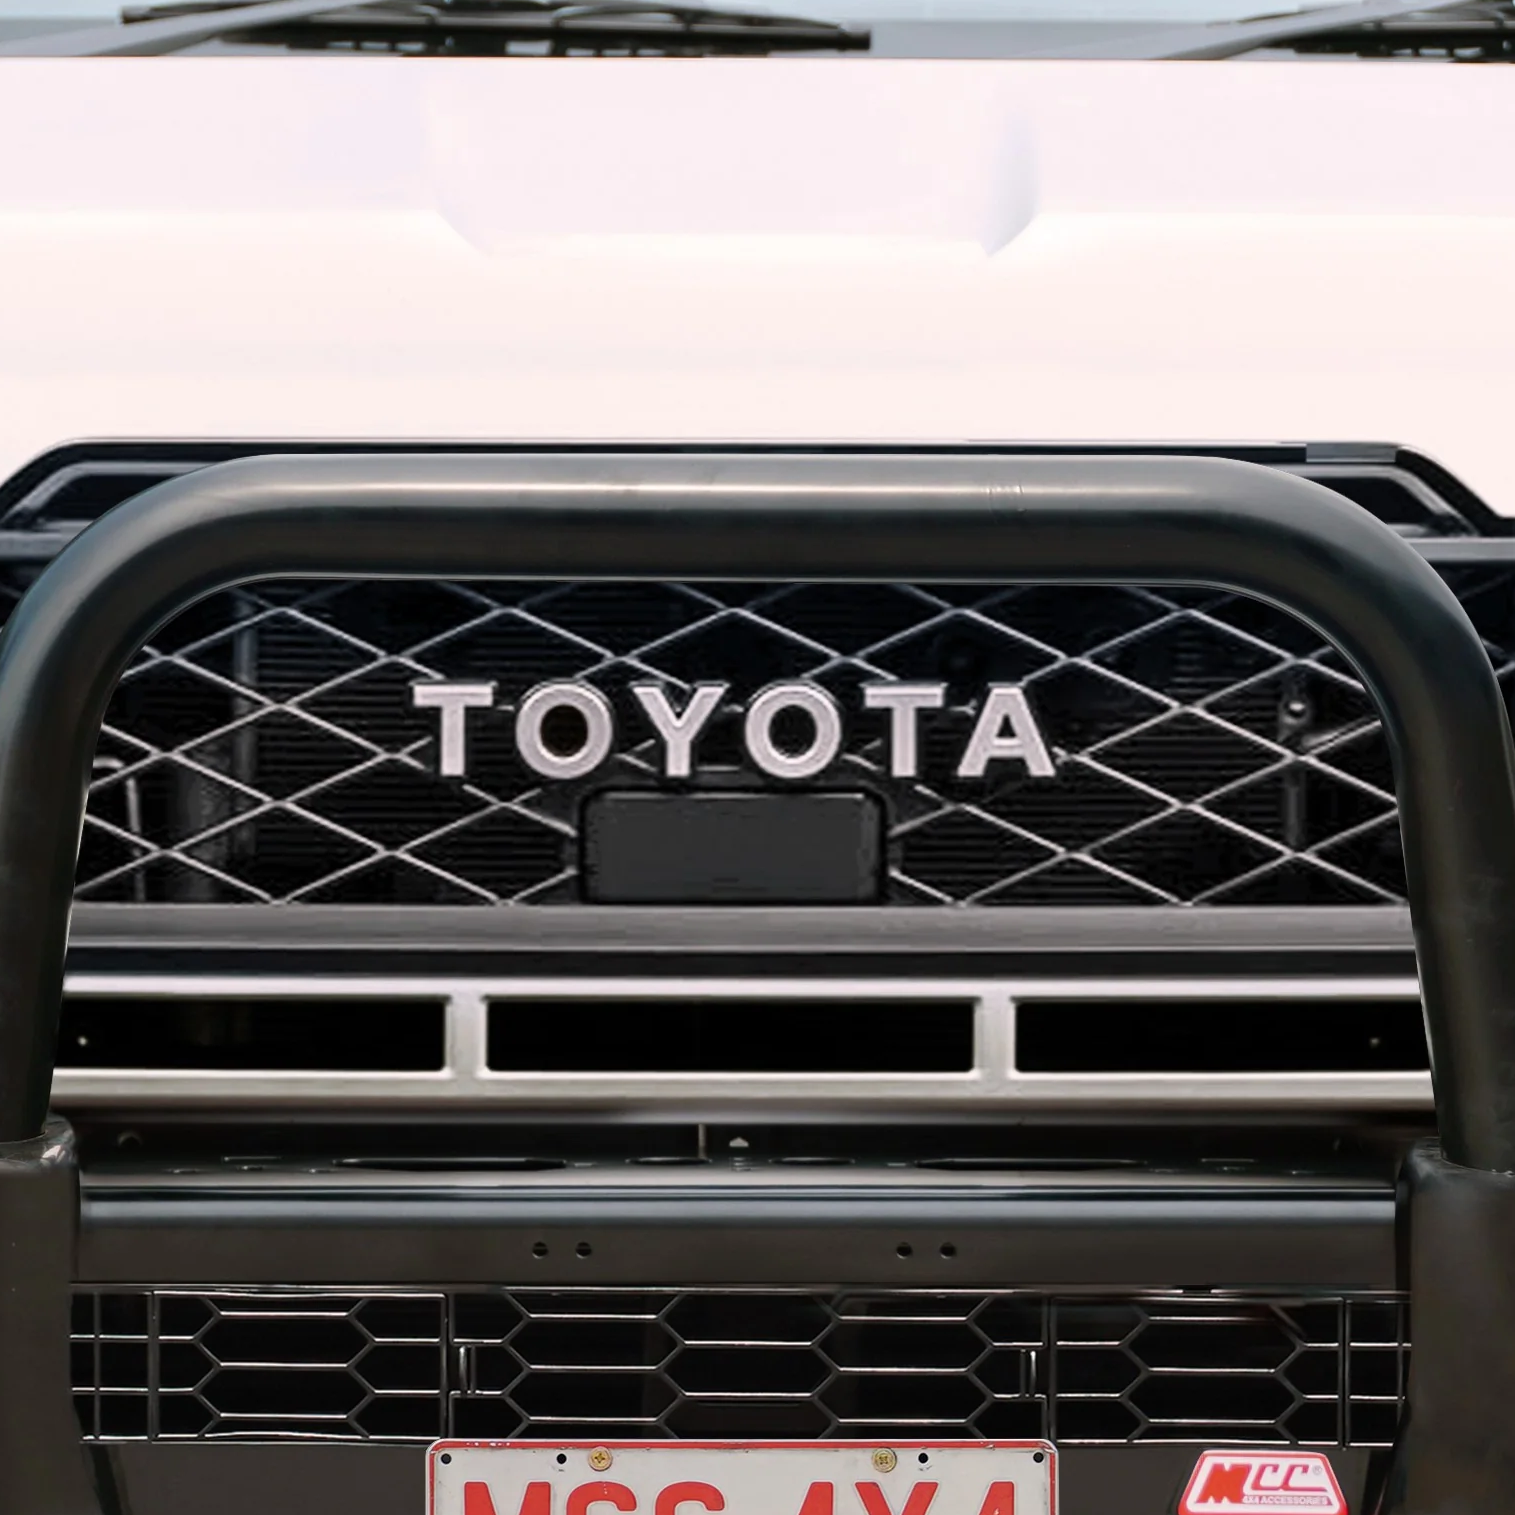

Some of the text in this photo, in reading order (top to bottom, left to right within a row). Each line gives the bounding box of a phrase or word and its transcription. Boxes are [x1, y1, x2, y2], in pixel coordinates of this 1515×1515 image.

[412, 683, 1056, 779] TOYOTA
[1195, 1463, 1328, 1505] MCC
[1261, 1496, 1329, 1506] ACCESSORIES
